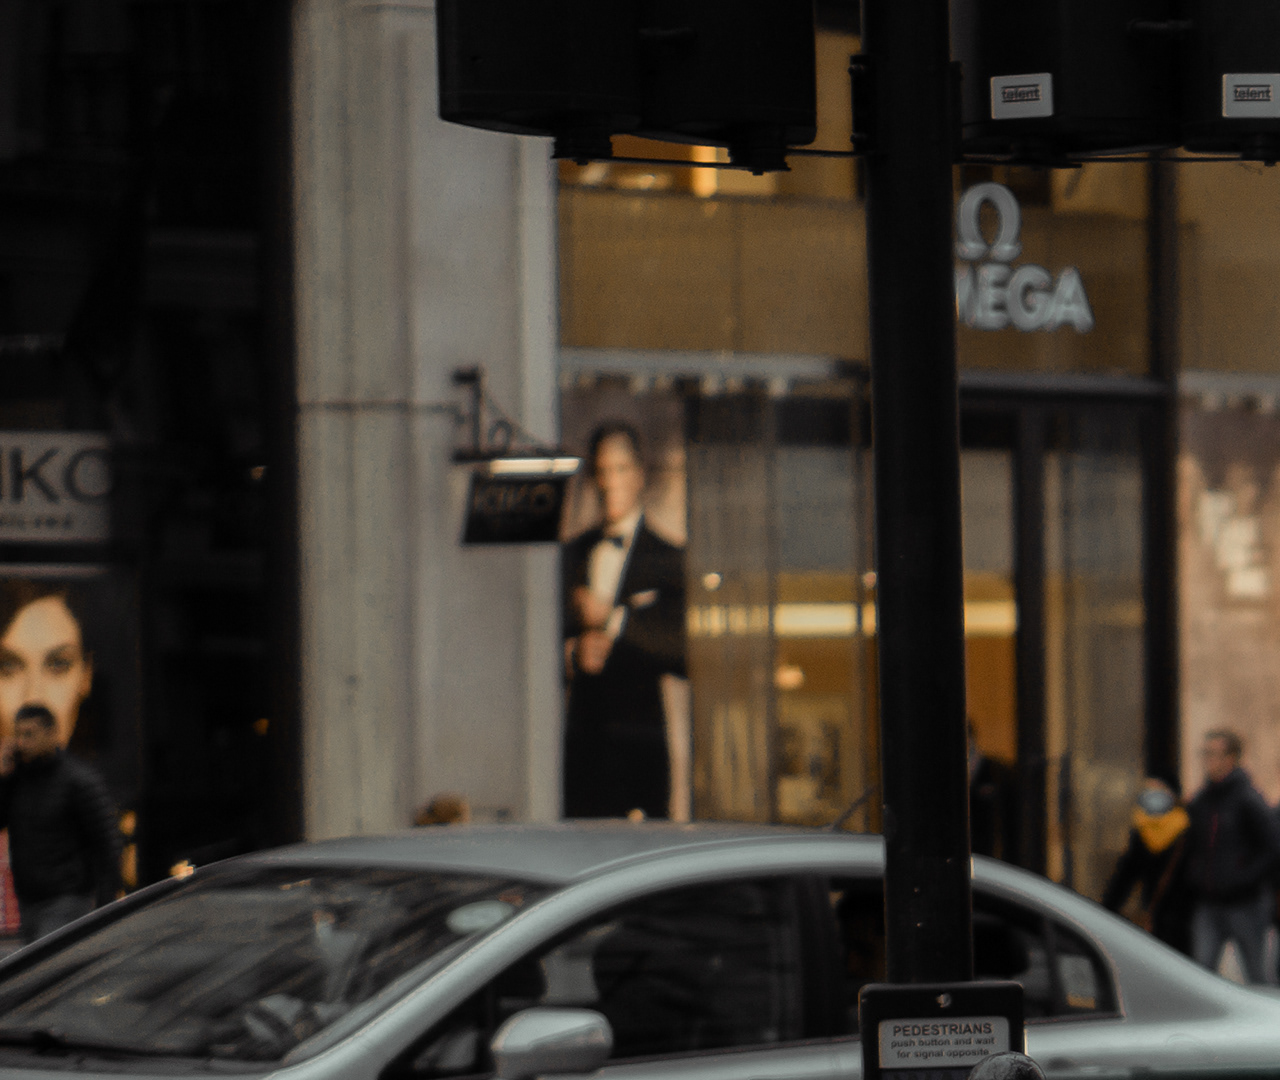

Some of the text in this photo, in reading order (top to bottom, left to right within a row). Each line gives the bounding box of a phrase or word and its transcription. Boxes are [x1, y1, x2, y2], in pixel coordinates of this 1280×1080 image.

[1001, 88, 1040, 100] telent
[1233, 88, 1271, 99] telent
[893, 1022, 992, 1037] PEDESTRIANS
[891, 1036, 995, 1049] push button and wait
[896, 1048, 990, 1060] for signal opposite
